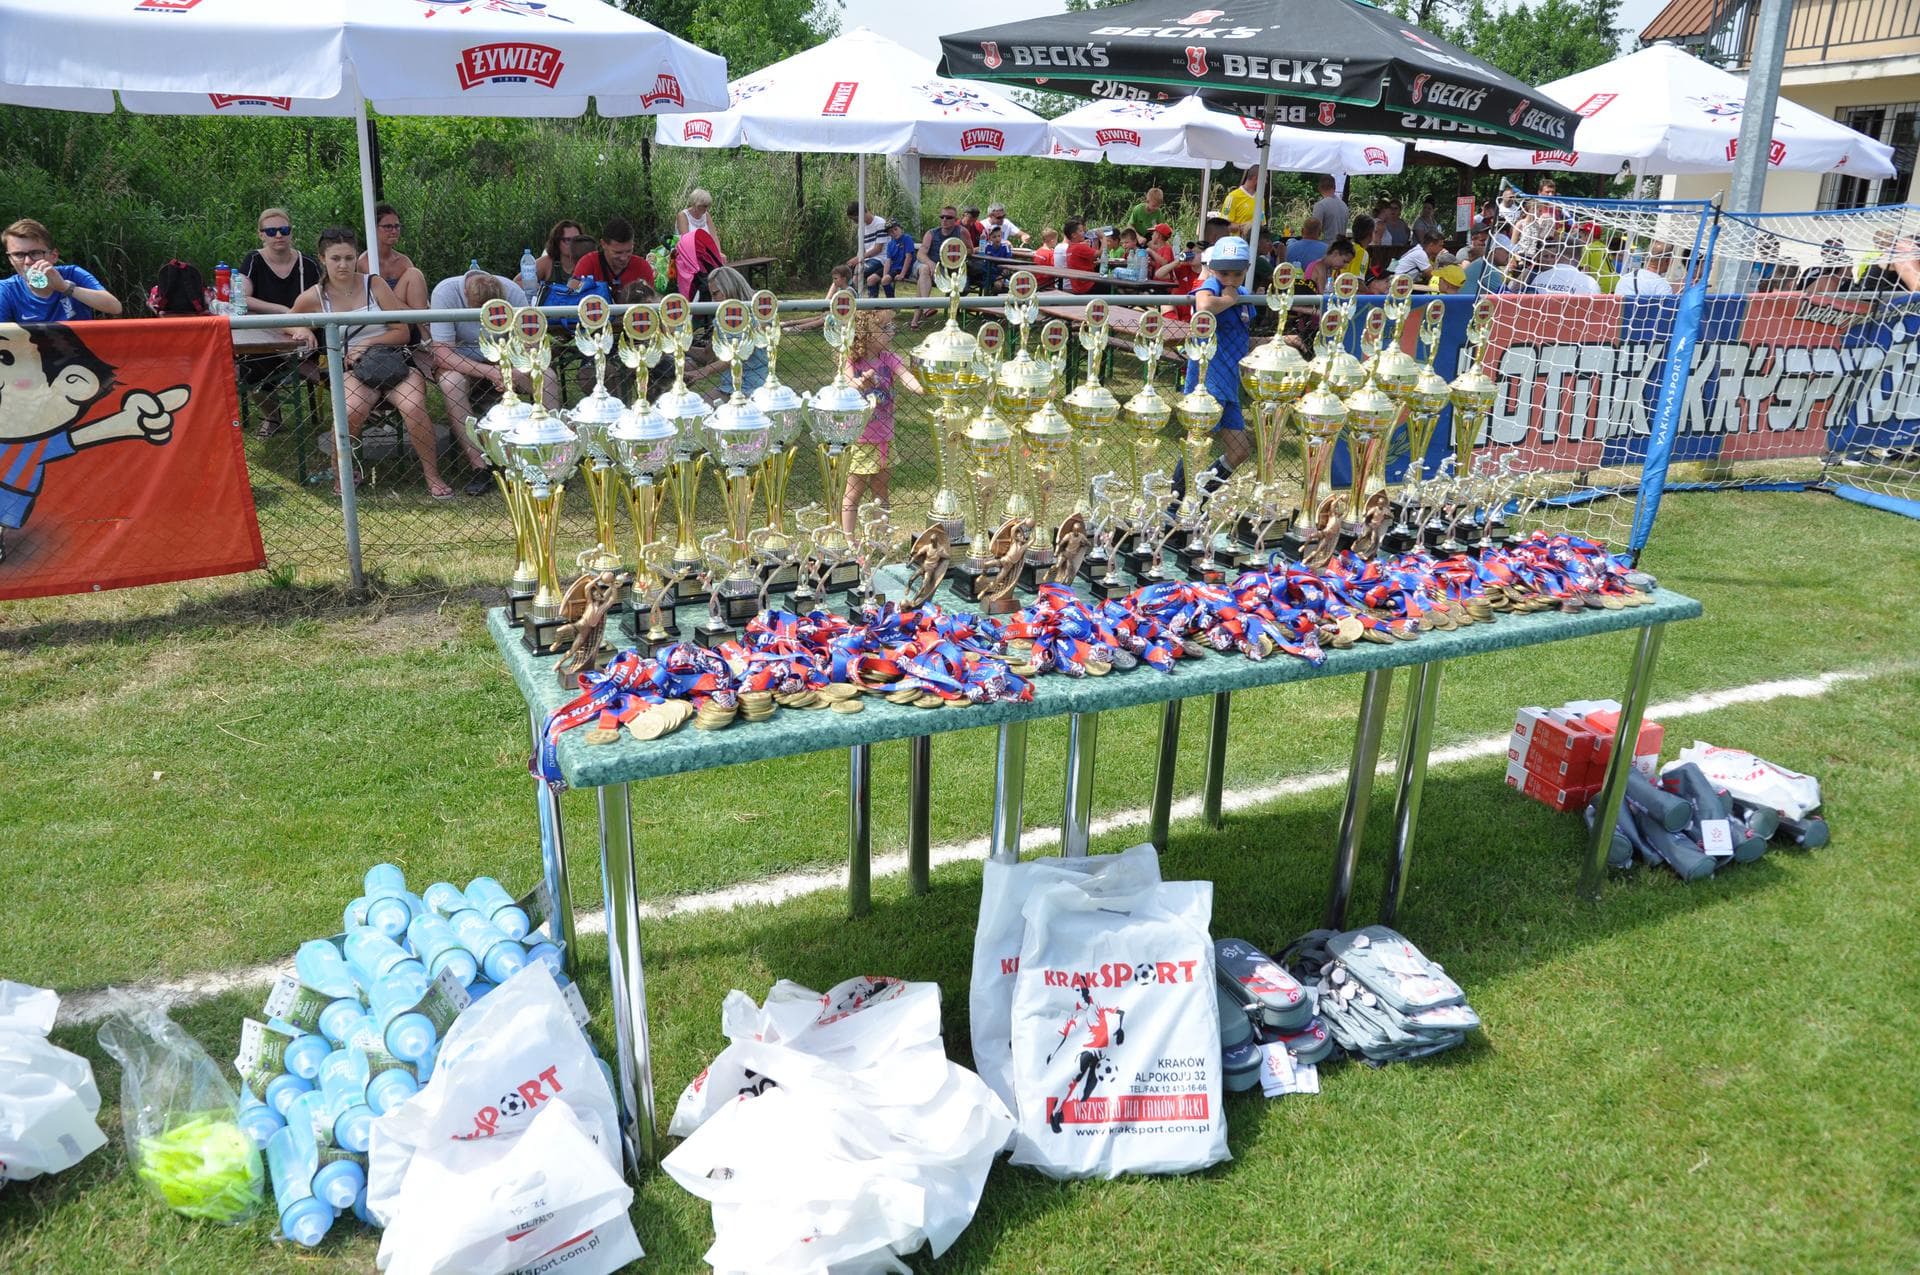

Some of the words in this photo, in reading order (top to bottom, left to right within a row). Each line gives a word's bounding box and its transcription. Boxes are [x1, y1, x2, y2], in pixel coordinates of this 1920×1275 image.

[1090, 26, 1262, 39] BECK'S
[472, 47, 553, 75] ŻYWIEC
[1011, 42, 1109, 67] BECK'S
[1223, 54, 1343, 87] BECK'S
[1428, 81, 1488, 111] BECK'S
[967, 130, 1000, 144] ŻYWIEC
[1522, 108, 1565, 139] BECK'S
[1656, 355, 1682, 446] YAKIMASPORT
[570, 686, 618, 717] Kryspin
[1158, 1056, 1205, 1069] KRAKÓW
[1194, 1071, 1206, 1081] 32
